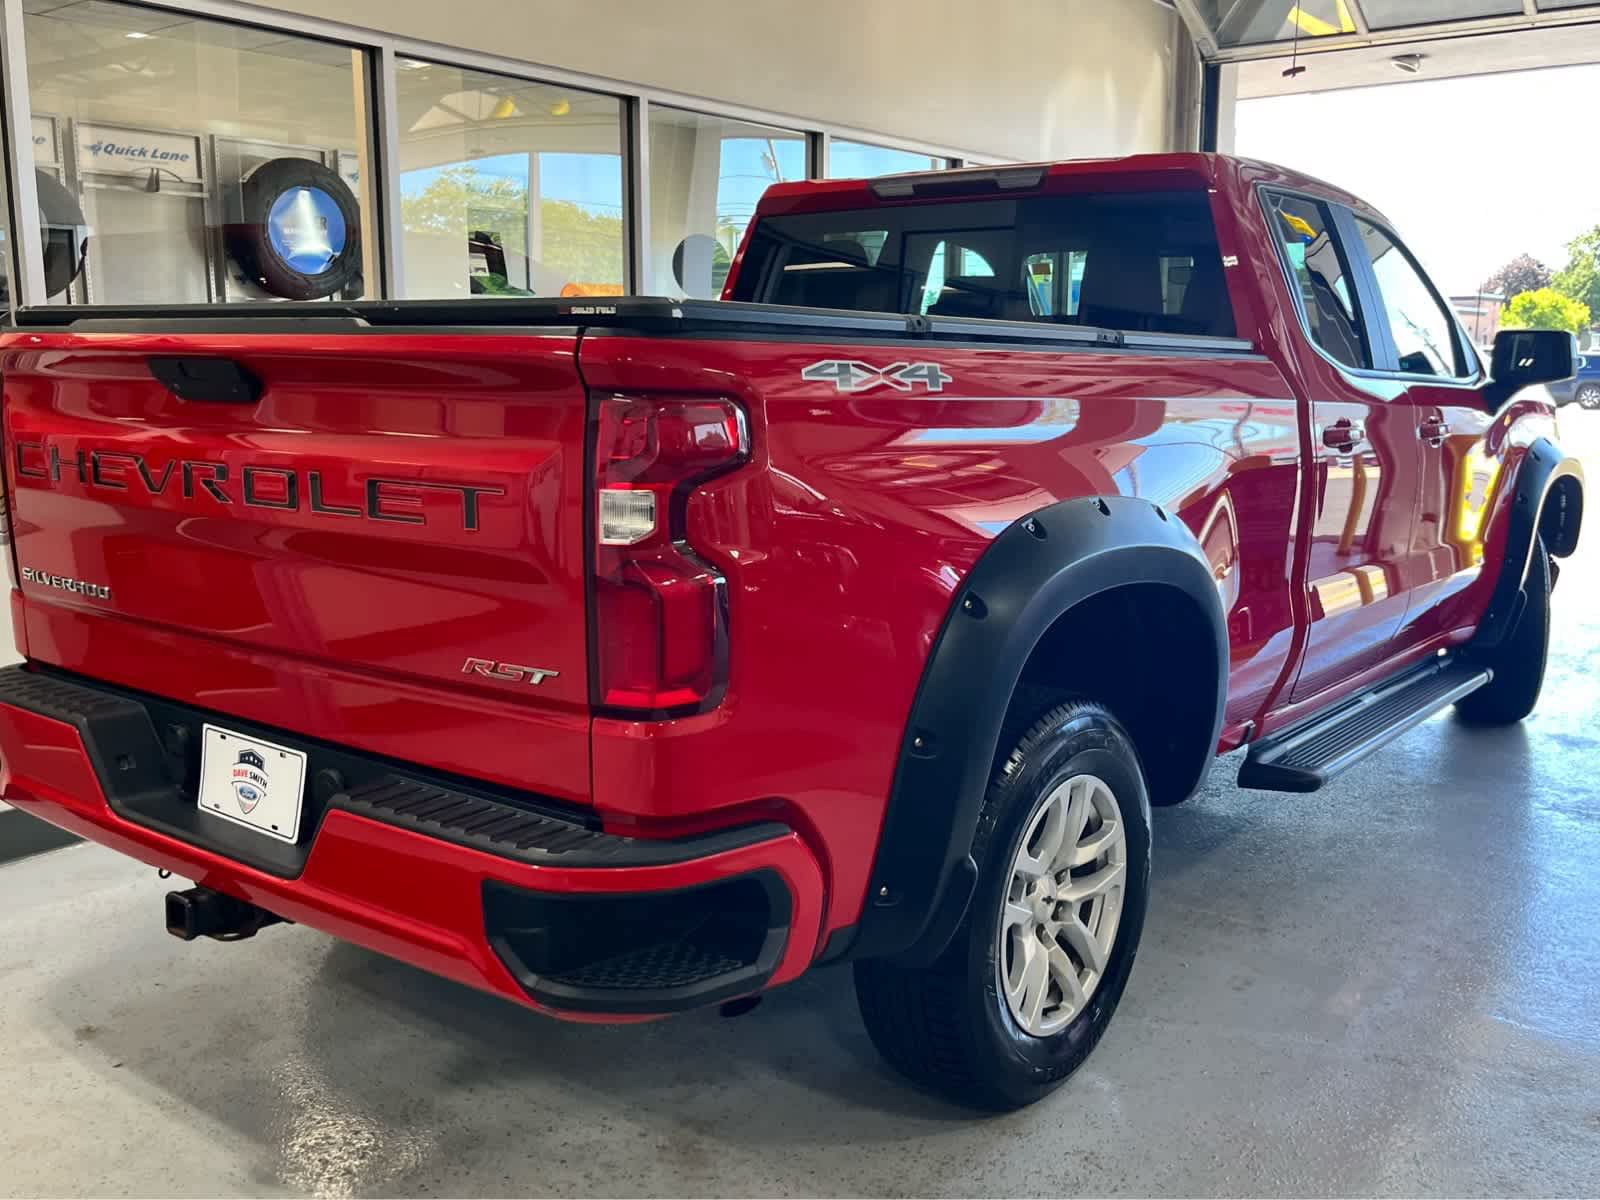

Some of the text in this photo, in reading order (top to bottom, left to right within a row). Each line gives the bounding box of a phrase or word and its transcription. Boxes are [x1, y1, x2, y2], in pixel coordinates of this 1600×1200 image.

[103, 143, 149, 158] Quick
[151, 148, 191, 162] Lane
[16, 440, 505, 532] CHEVROLET
[22, 567, 111, 600] SILVERADO
[461, 657, 560, 686] RST
[233, 769, 267, 788] DAVE SMITH
